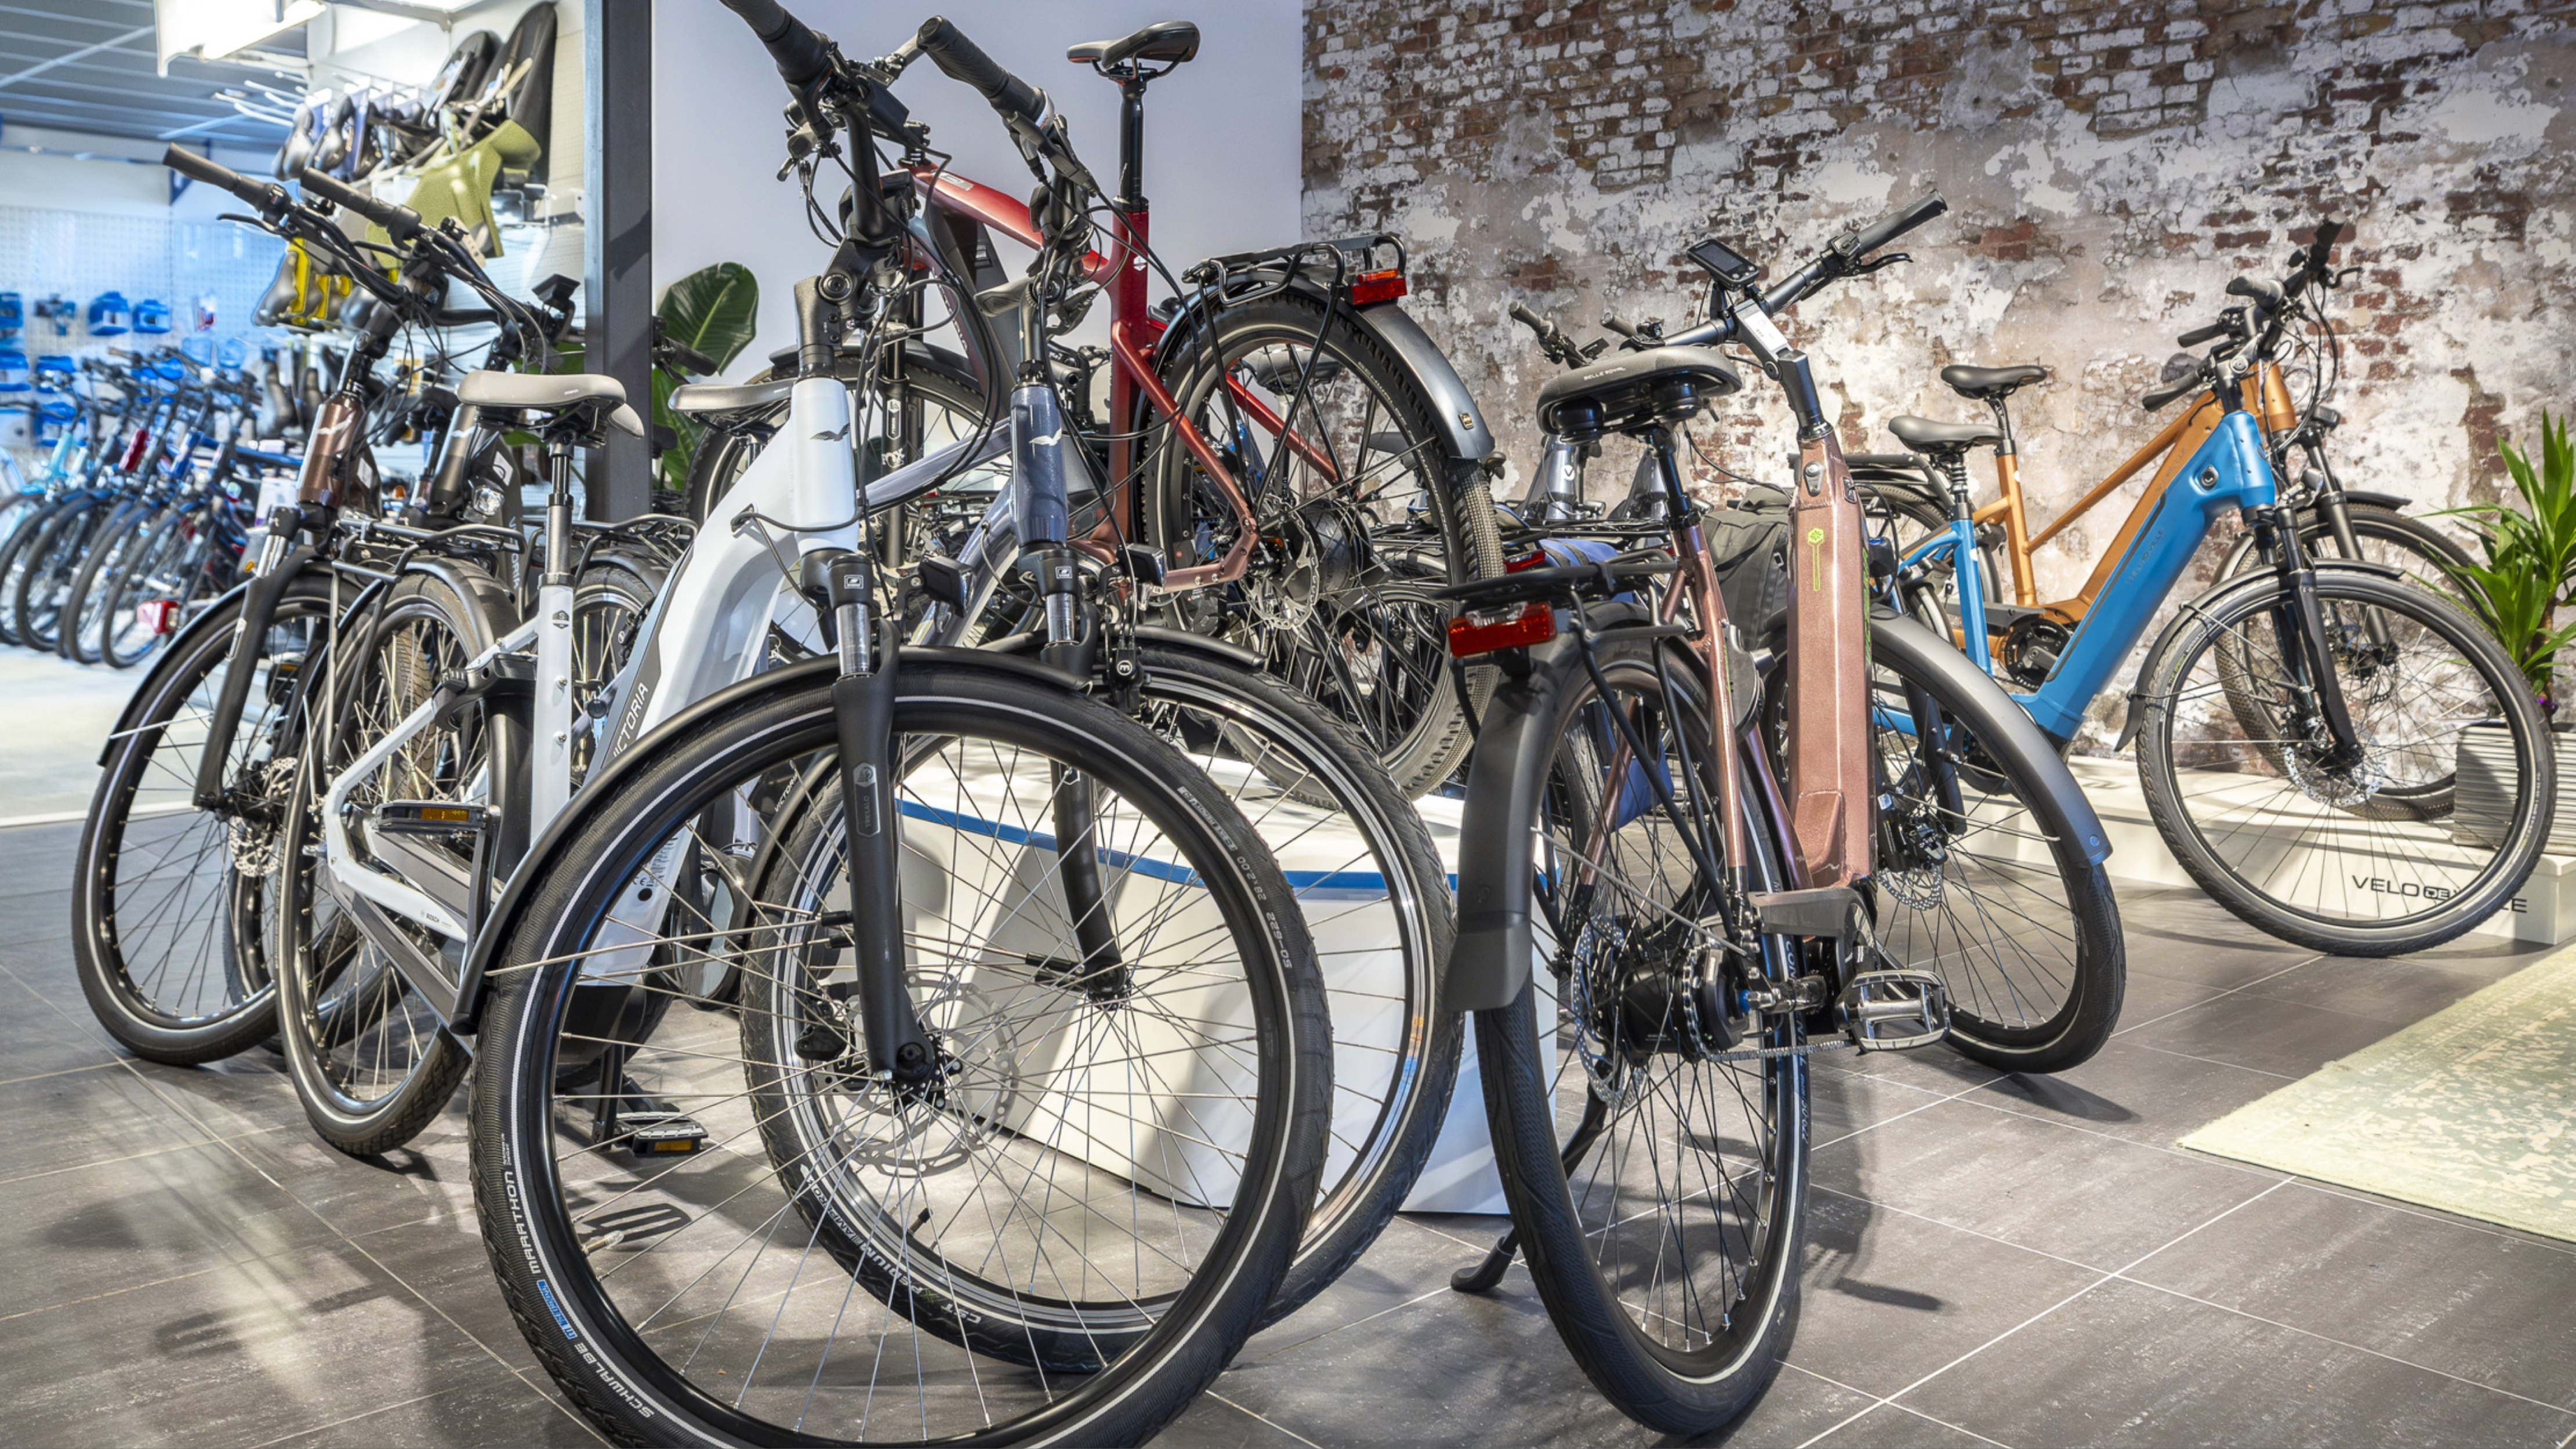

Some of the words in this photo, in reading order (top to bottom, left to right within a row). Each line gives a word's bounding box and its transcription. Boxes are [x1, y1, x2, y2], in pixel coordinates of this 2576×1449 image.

[509, 515, 521, 590] VORIA
[613, 682, 648, 757] ICTORIA
[2352, 874, 2419, 897] VELO
[1266, 911, 1293, 969] 50-622
[504, 1170, 542, 1275] MARATHON
[574, 1342, 655, 1418] SCHWALBE
